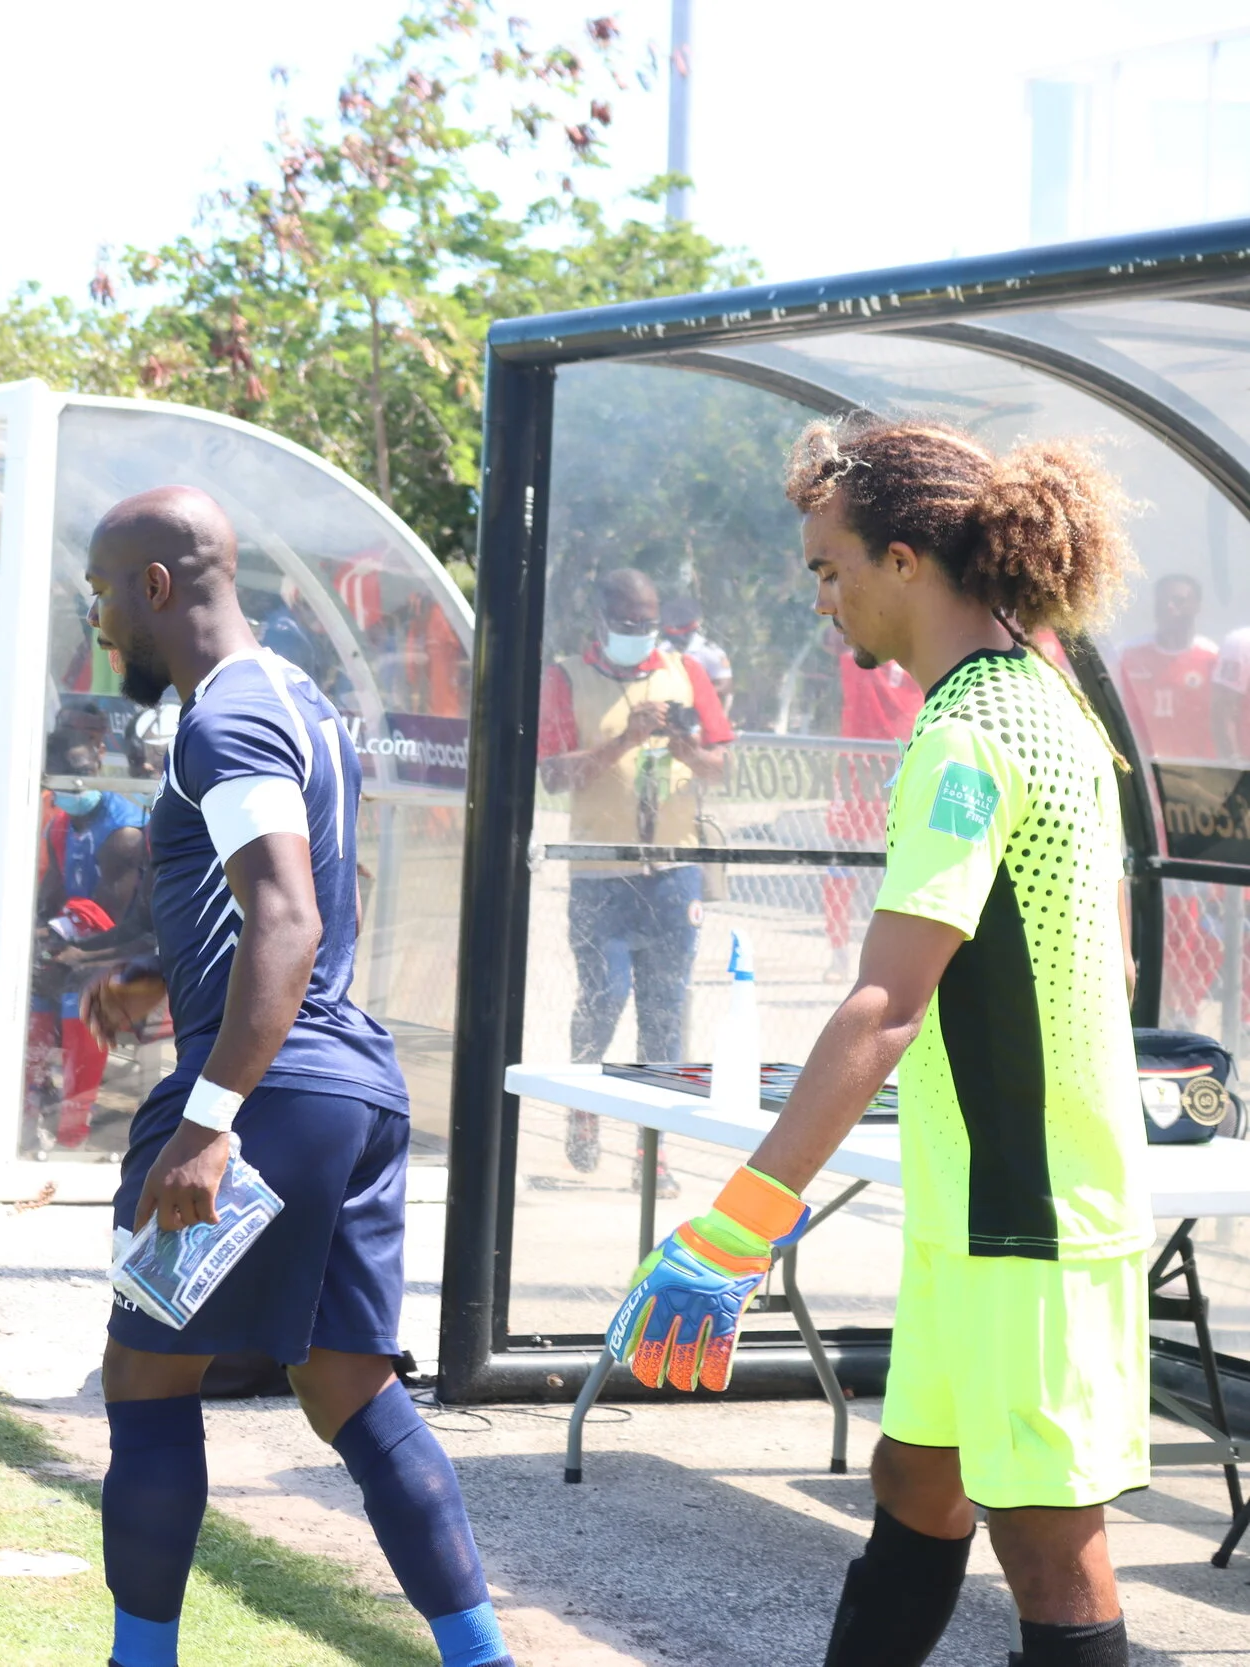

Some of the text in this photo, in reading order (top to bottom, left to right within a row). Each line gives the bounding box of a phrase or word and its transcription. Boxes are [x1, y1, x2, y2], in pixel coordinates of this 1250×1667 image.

[943, 787, 990, 810] FOOTBALL
[945, 780, 993, 803] LIVING
[186, 1214, 266, 1305] TURKS & CAICOS ISLANDS
